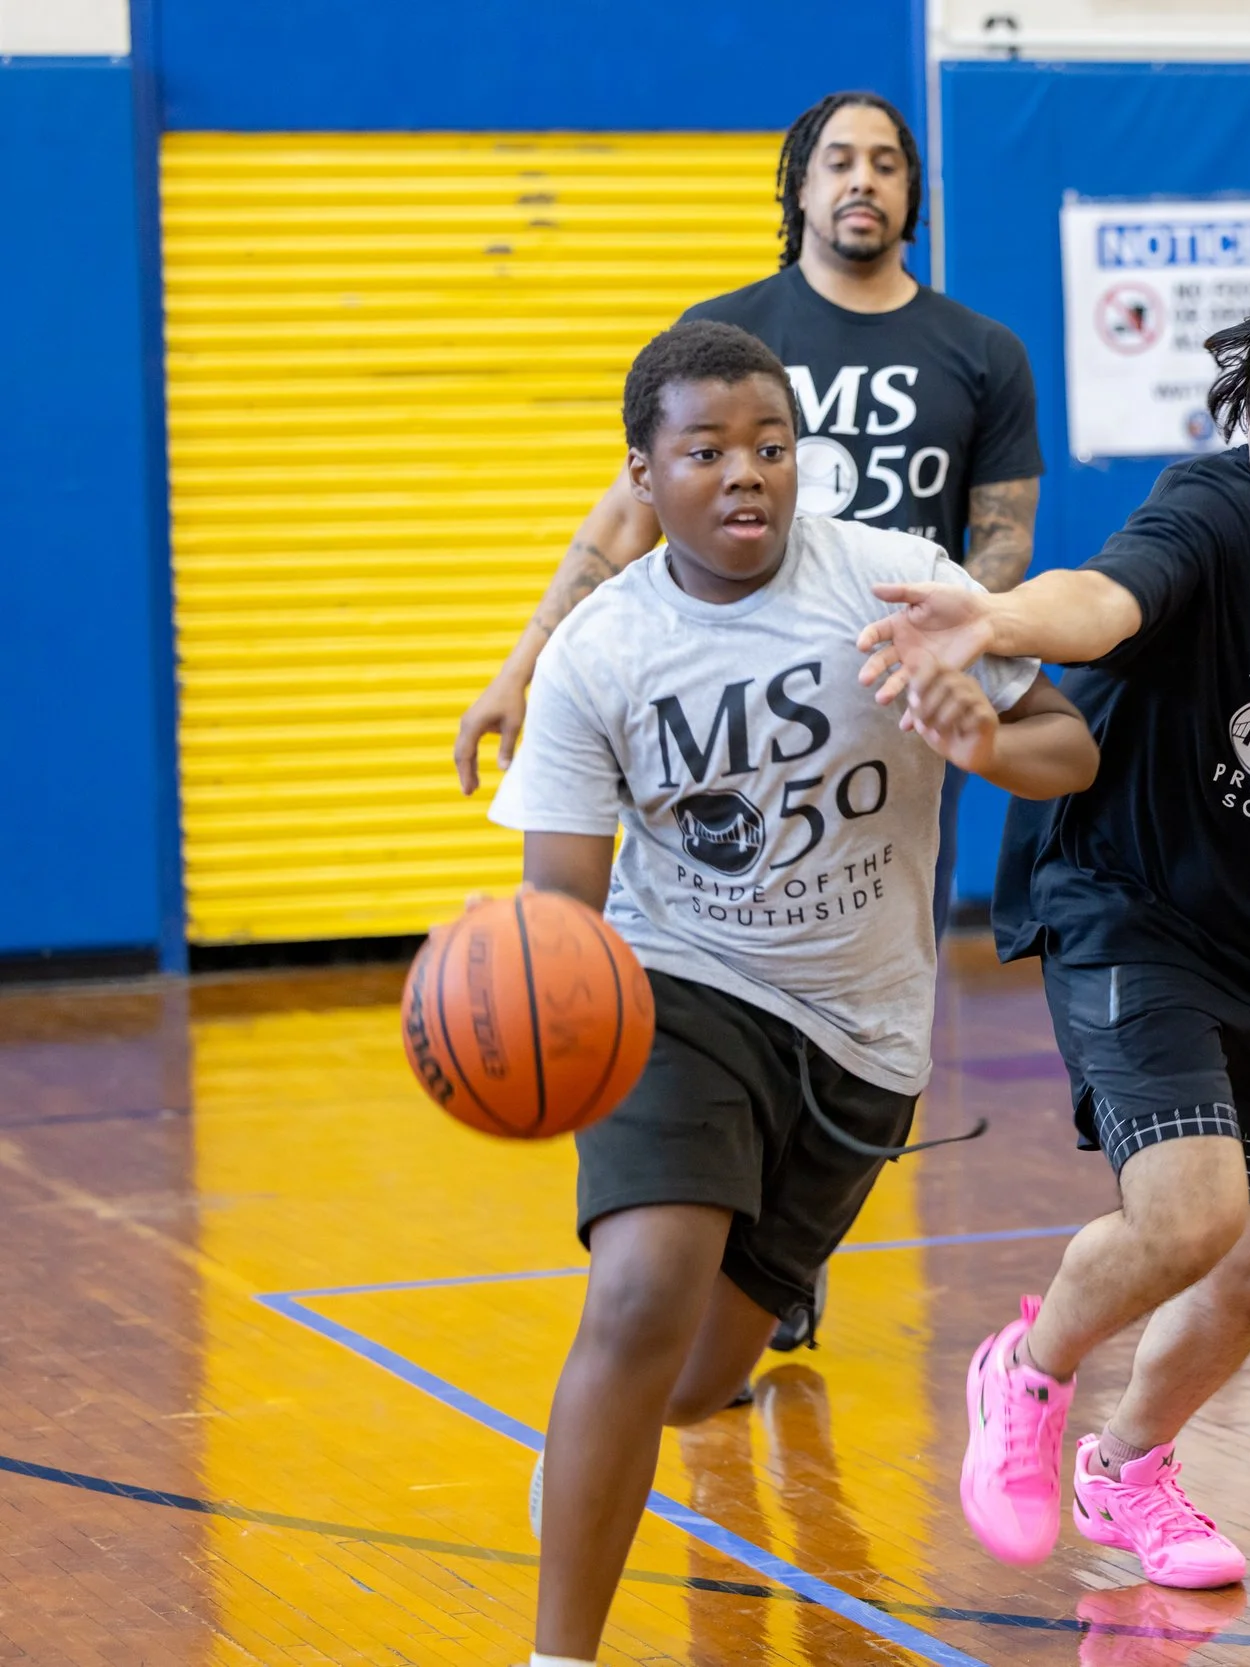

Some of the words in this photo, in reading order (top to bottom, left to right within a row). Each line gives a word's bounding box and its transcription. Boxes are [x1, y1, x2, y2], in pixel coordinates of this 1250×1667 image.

[784, 365, 919, 436] MS
[853, 445, 950, 520] 50
[650, 661, 831, 789] MS
[769, 759, 888, 870] 50
[677, 865, 766, 903] PRIDE
[784, 873, 829, 899] OF
[844, 844, 893, 884] THE
[692, 878, 885, 927] SOUTHSIDE
